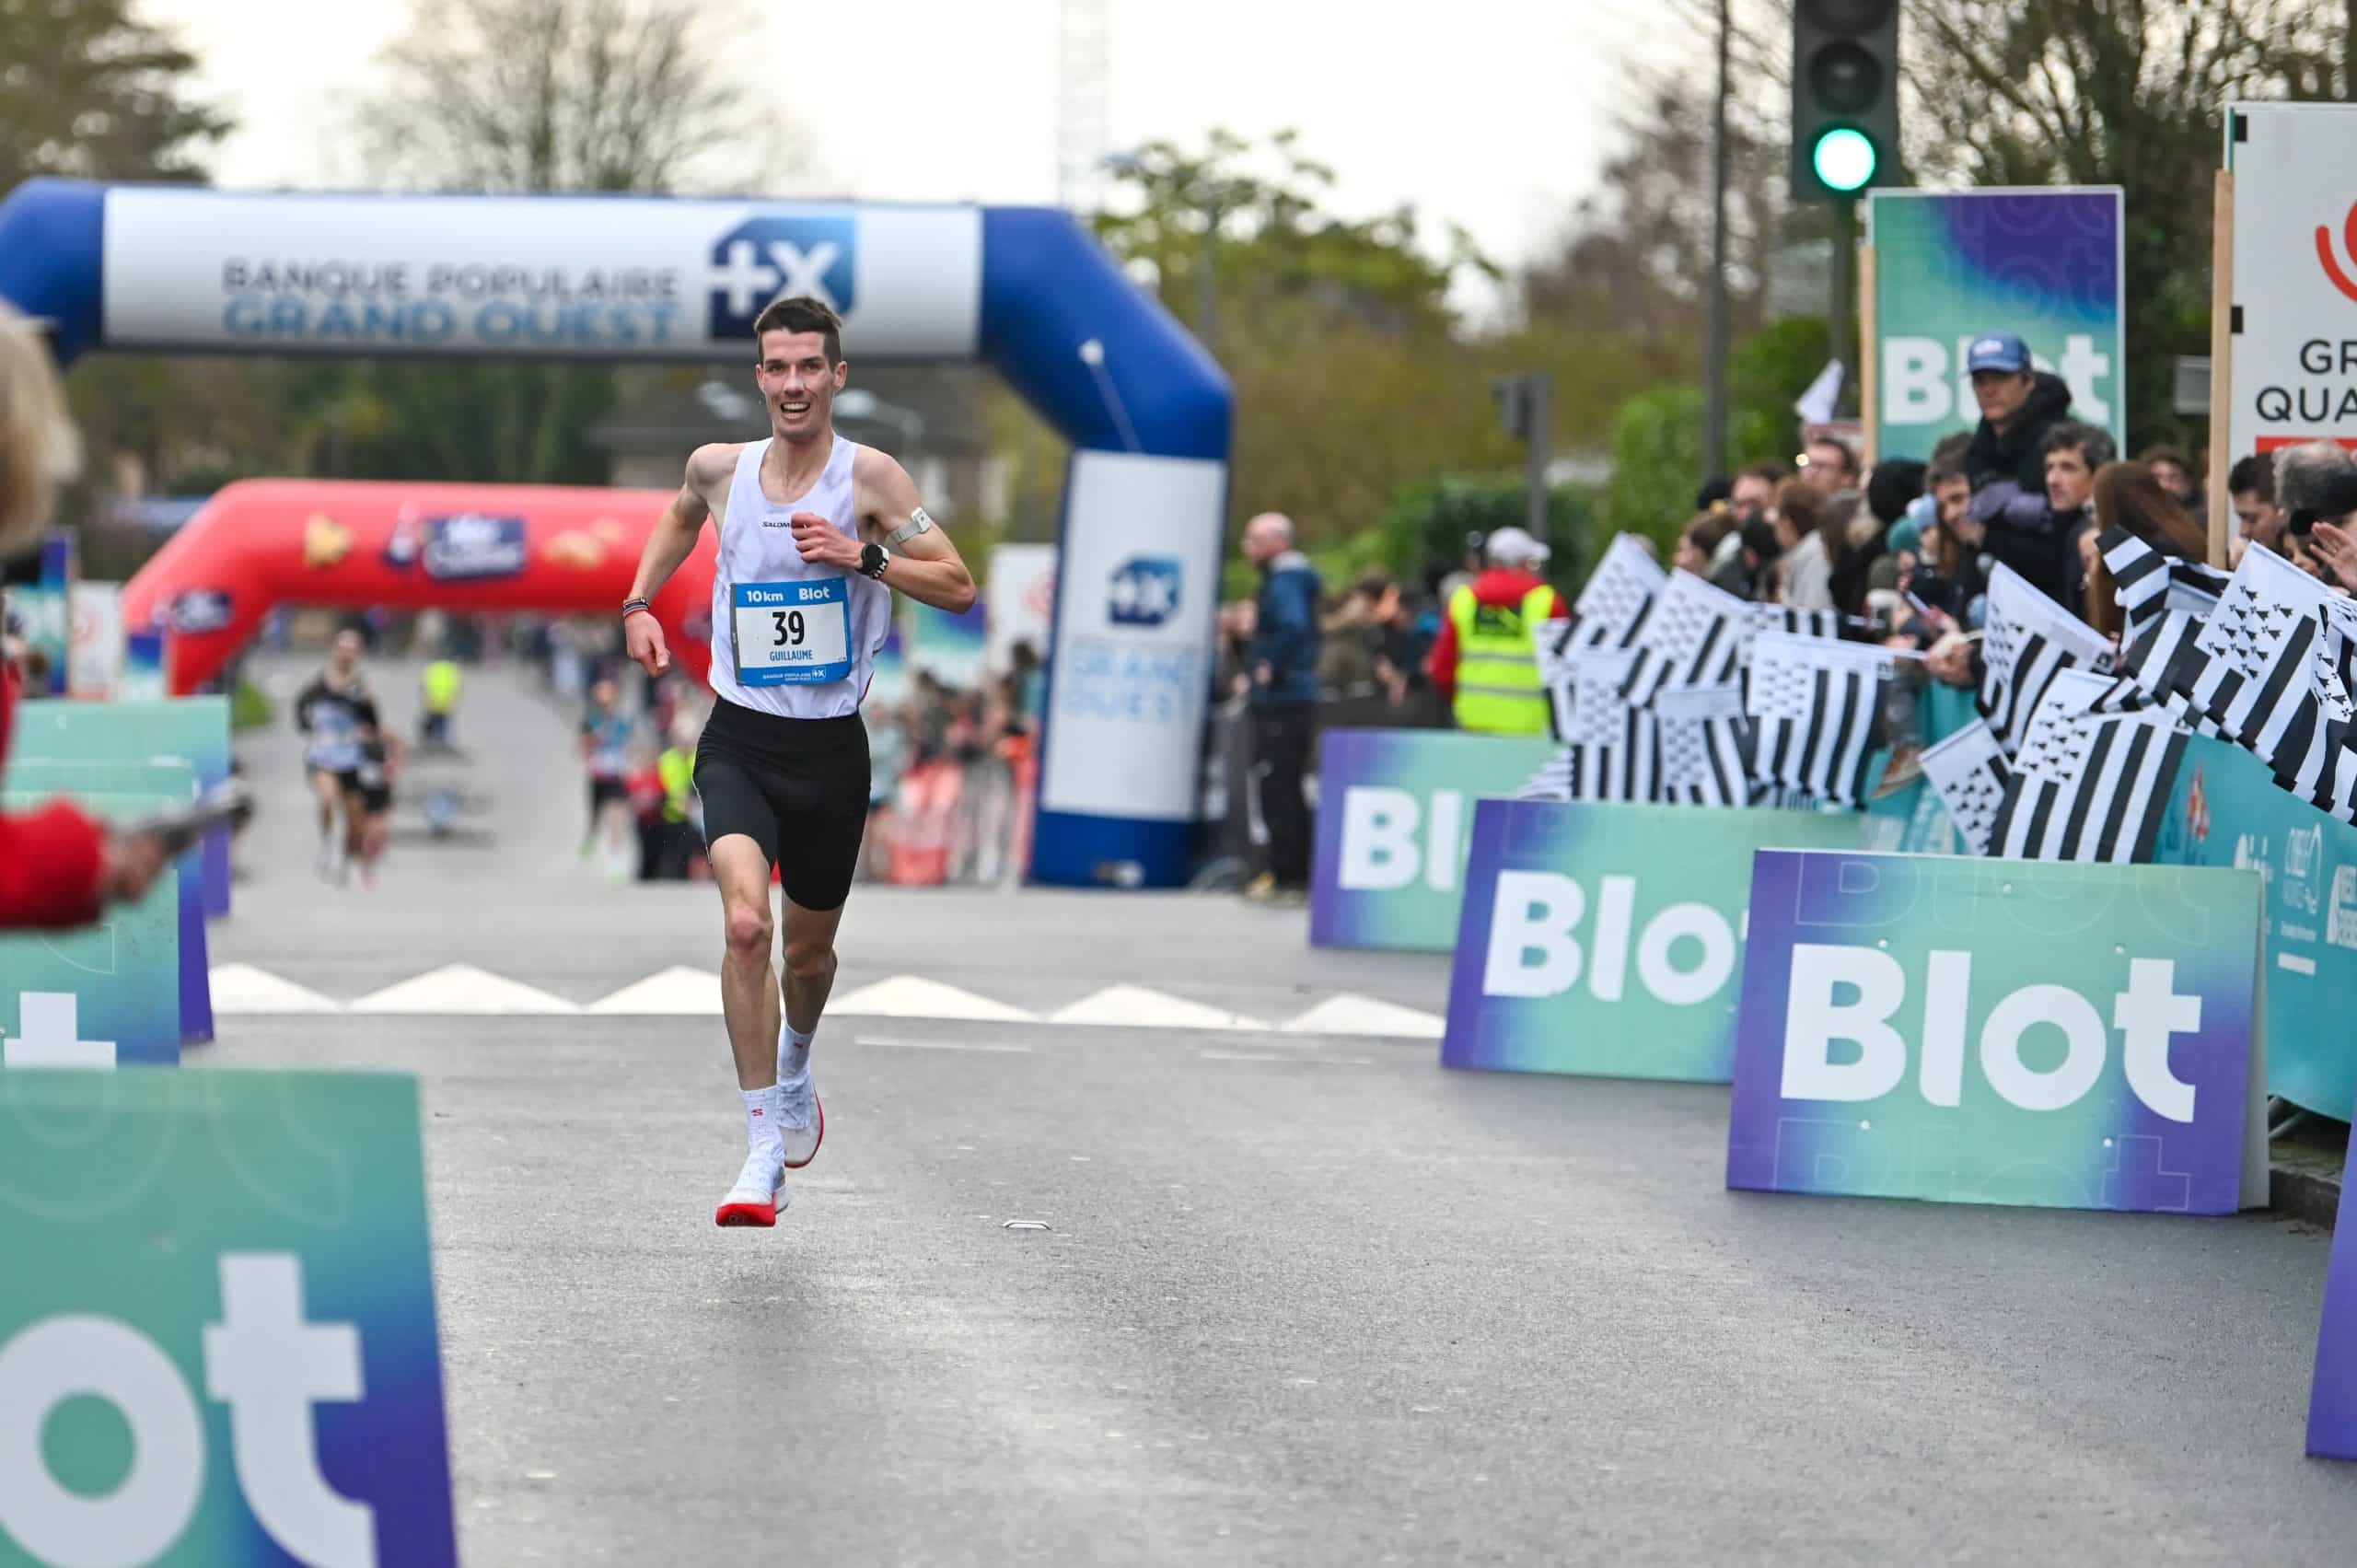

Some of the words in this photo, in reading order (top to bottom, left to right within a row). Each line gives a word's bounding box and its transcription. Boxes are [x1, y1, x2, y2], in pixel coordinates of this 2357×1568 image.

[222, 259, 410, 295] BANQUE
[427, 262, 679, 297] POPULAIRE
[222, 294, 456, 339] GRAND
[473, 299, 679, 341] OUEST
[1882, 333, 2110, 426] Blt
[798, 587, 830, 600] Blot
[772, 610, 805, 645] 39
[769, 649, 813, 661] GUILLAUME
[1338, 786, 1464, 892] Bl
[1482, 869, 1748, 1005] Blo
[1780, 943, 2202, 1122] Blot
